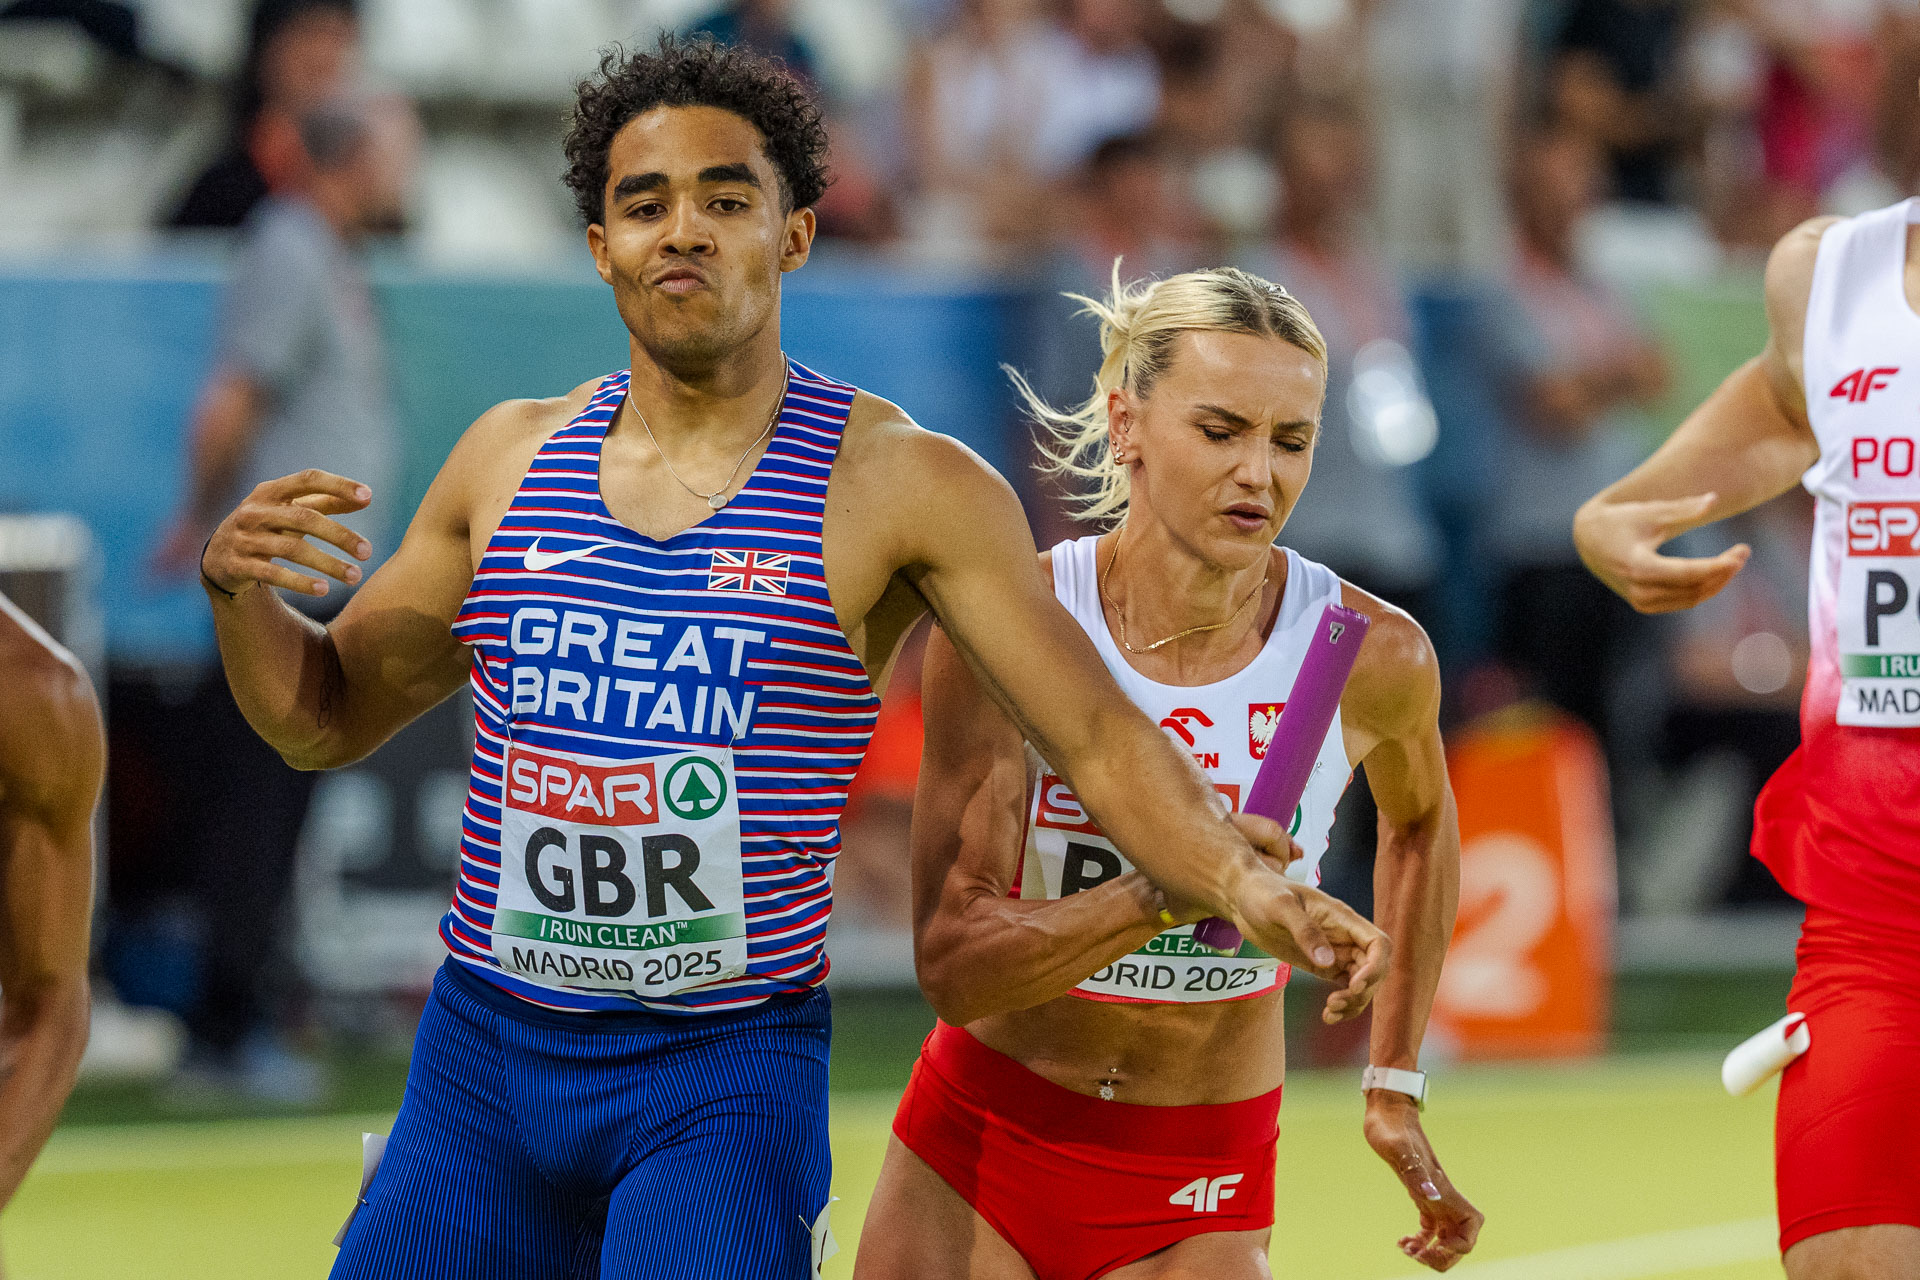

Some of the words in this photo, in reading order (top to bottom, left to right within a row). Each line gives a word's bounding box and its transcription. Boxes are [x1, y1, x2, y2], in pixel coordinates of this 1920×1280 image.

[1829, 368, 1899, 402] 4F
[1852, 437, 1920, 478] PO
[511, 607, 767, 677] GREAT
[1329, 621, 1345, 644] 7
[1891, 656, 1920, 676] RU
[512, 666, 756, 740] BRITAIN
[509, 759, 655, 819] SPAR
[524, 827, 716, 918] GBR
[539, 918, 547, 938] I
[550, 919, 592, 944] RUN
[1145, 936, 1212, 954] CLEA
[512, 946, 633, 983] MADRID
[643, 949, 723, 986] 2025
[1089, 962, 1176, 990] DRID
[1183, 965, 1258, 992] 2025
[1169, 1172, 1244, 1212] 4F
